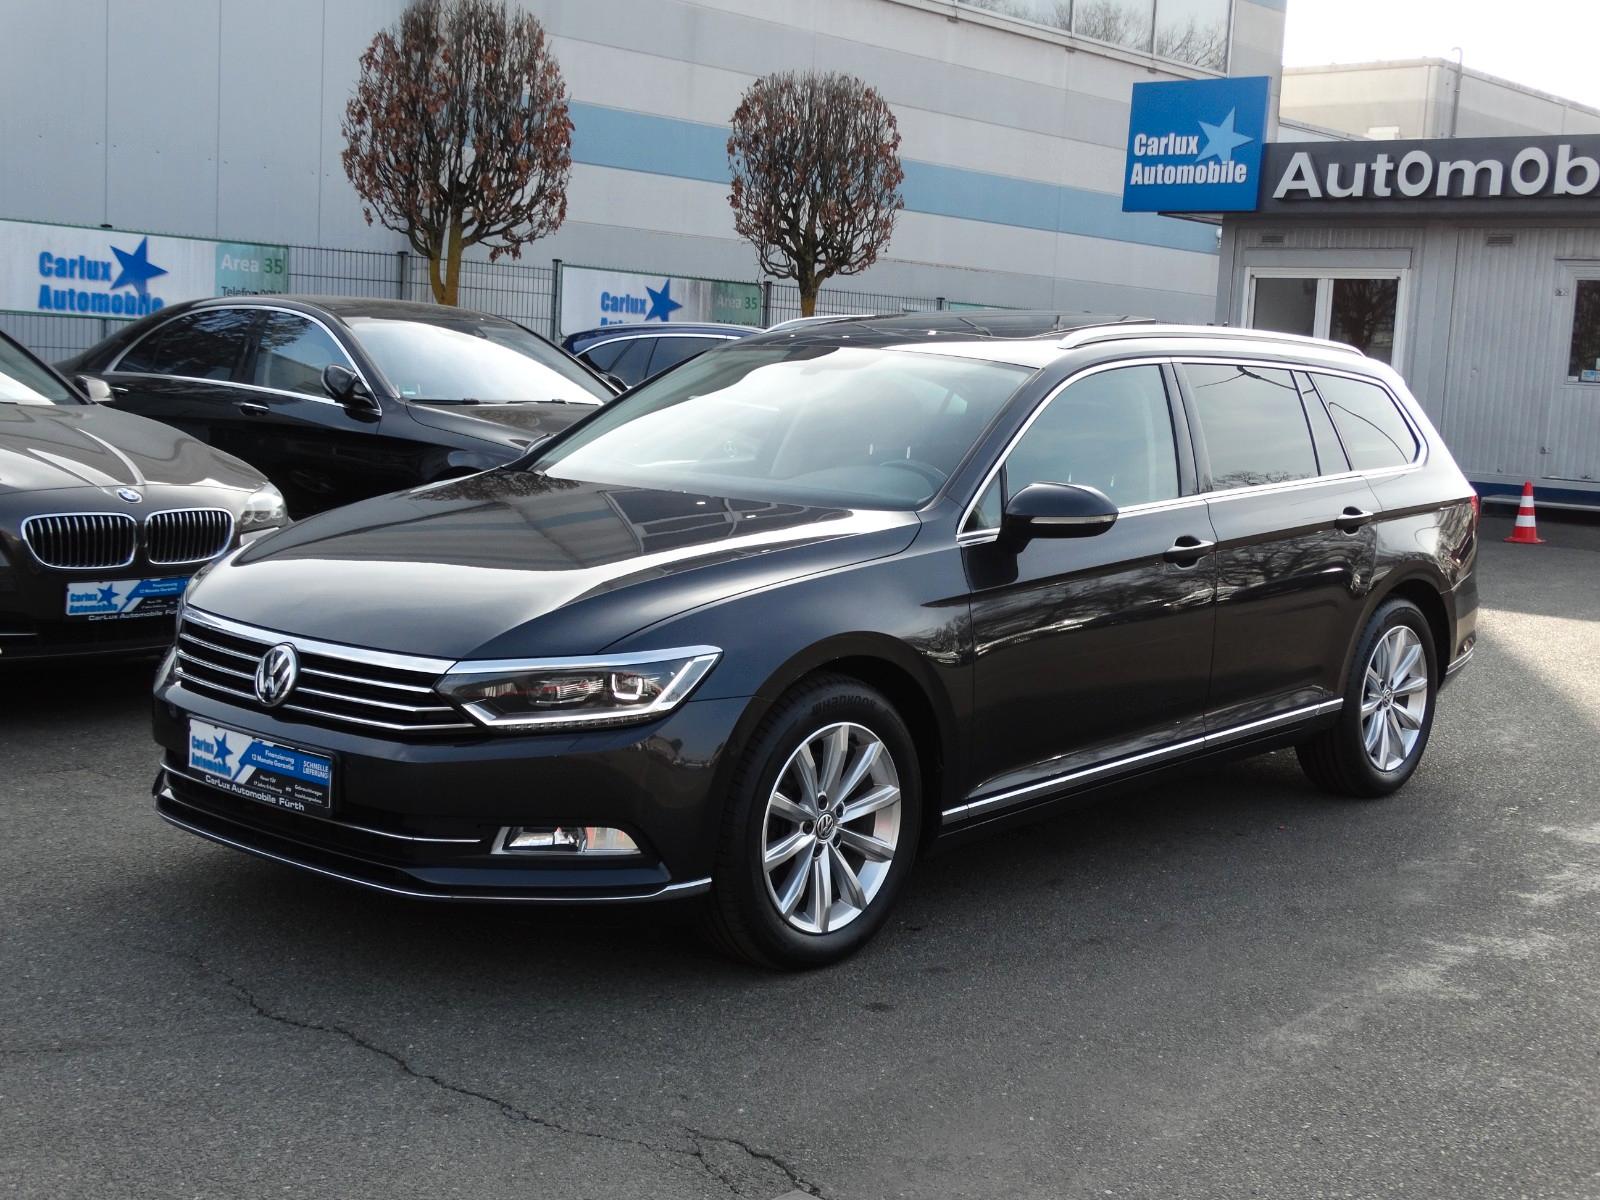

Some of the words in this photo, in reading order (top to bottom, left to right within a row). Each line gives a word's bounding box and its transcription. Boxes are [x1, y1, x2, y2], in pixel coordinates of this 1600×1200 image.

[1133, 131, 1199, 157] Carlux
[1129, 159, 1248, 186] Automobile
[38, 251, 112, 282] Carlux
[221, 254, 260, 273] Area
[263, 257, 284, 275] 35
[38, 284, 164, 316] Automobile
[600, 291, 647, 315] Carlux
[744, 296, 758, 310] 35
[303, 760, 329, 772] SCHNELLE
[231, 784, 277, 804] Automobile
[278, 797, 305, 812] Fürth
